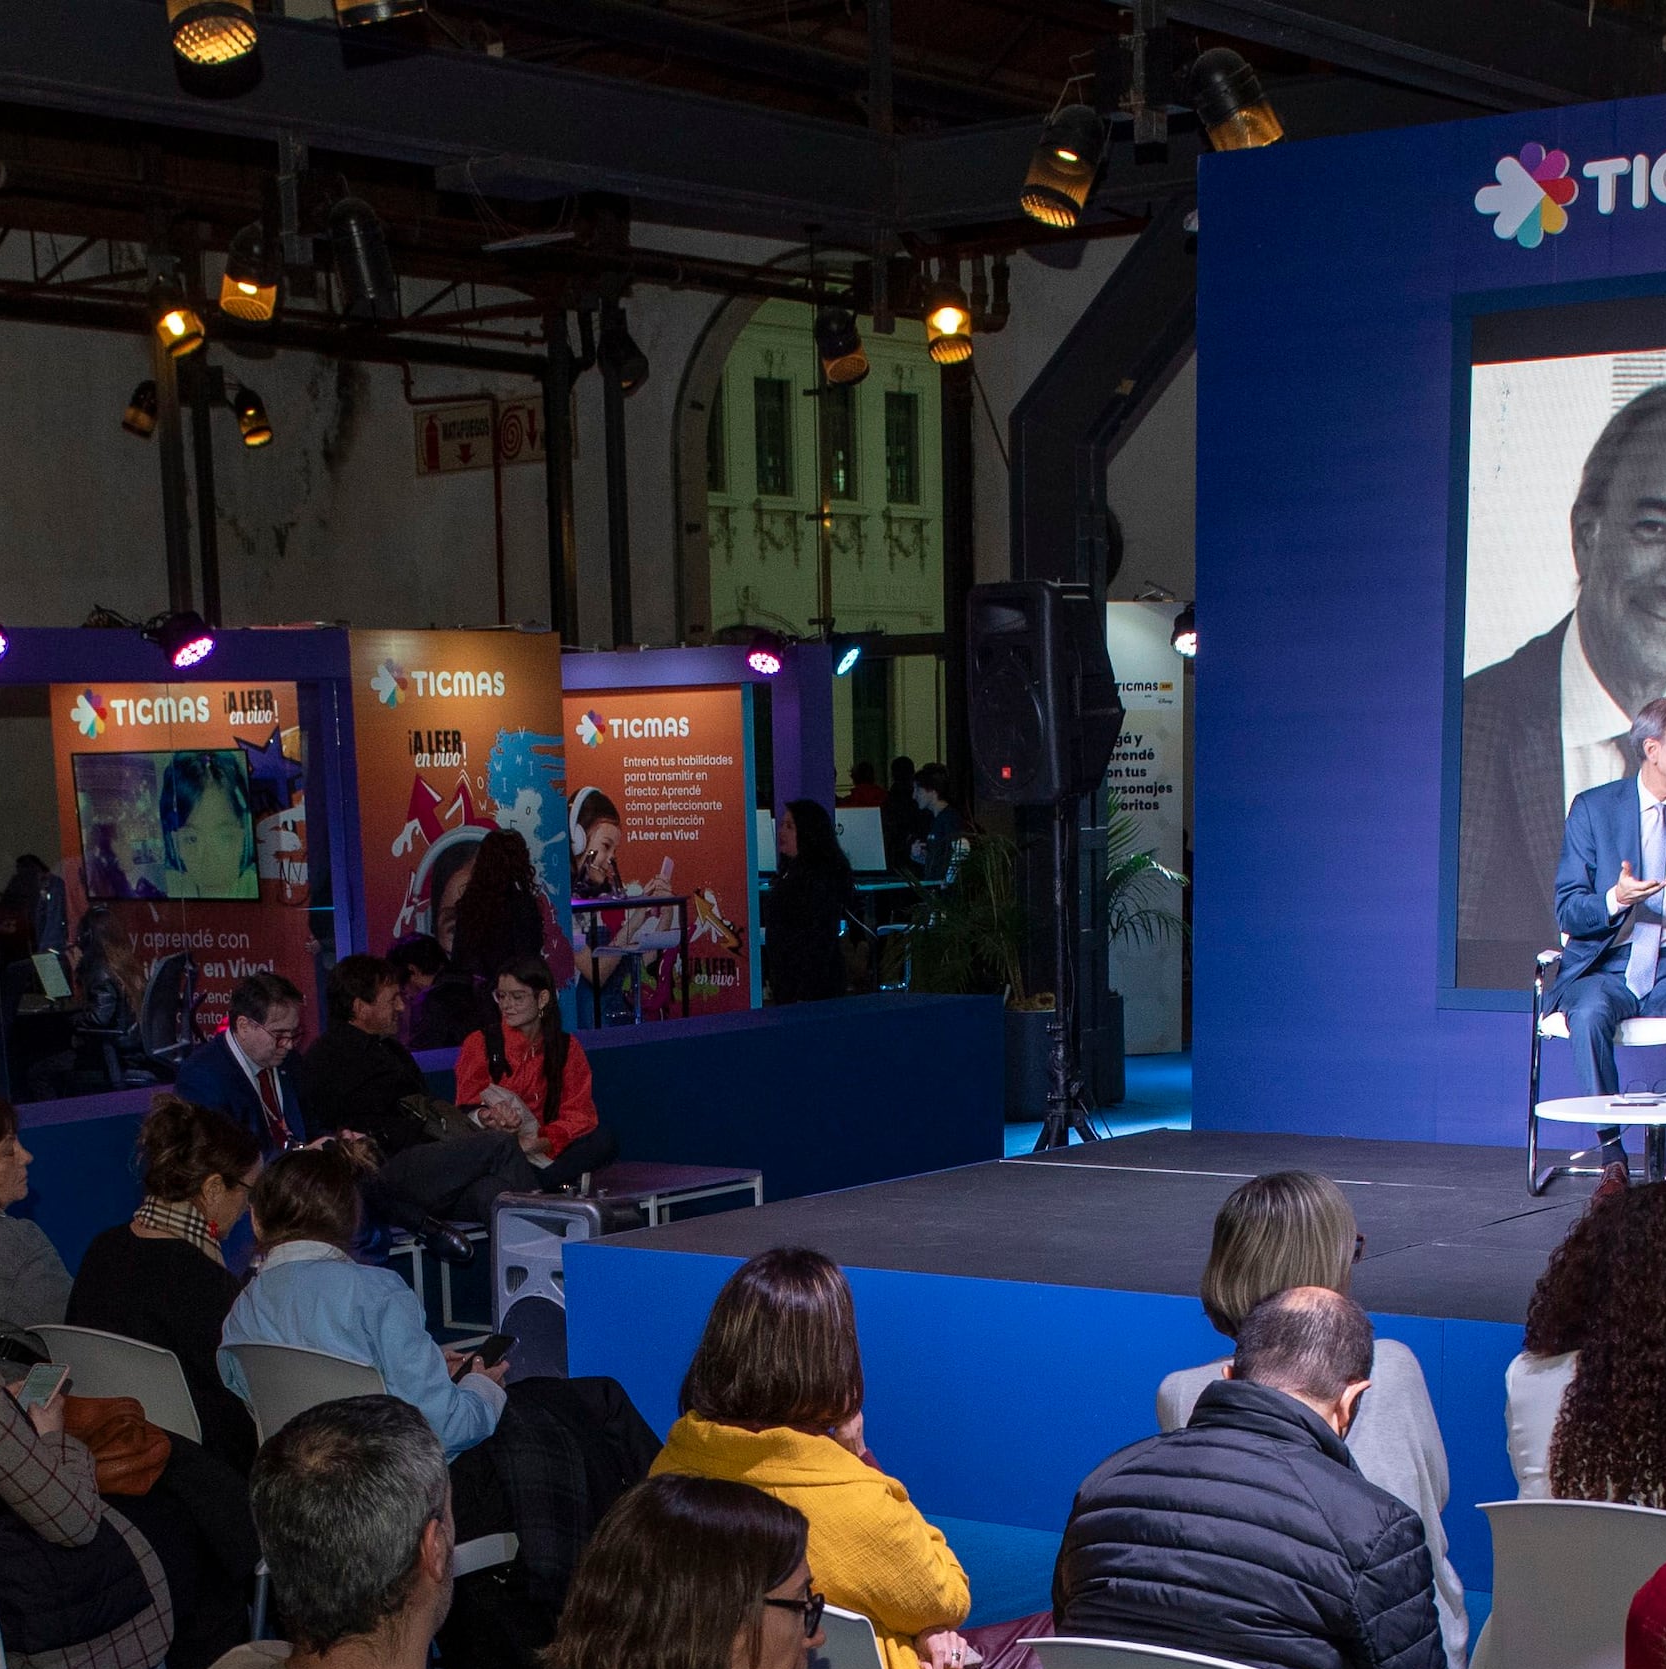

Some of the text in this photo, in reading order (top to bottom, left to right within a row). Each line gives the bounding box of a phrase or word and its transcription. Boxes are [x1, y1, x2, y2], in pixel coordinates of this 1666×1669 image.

[411, 671, 506, 697] TICMAS
[1117, 682, 1158, 692] TICMAS
[241, 689, 274, 711] LEER
[110, 696, 210, 726] TICMAS
[229, 708, 245, 726] en
[608, 716, 690, 739] TICMAS
[428, 730, 462, 755] LEER
[1134, 735, 1143, 748] y
[415, 751, 432, 768] en
[623, 755, 733, 768] Entrená tus habilidades
[624, 770, 708, 784] para transmitir en
[1107, 767, 1147, 778] on tus
[624, 785, 702, 798] directo: Aprendé
[625, 801, 723, 813] cómo perfeccionarte
[626, 815, 705, 828] con la aplicación
[639, 830, 659, 841] Leer
[660, 831, 672, 841] en
[673, 830, 699, 841] Vivo!
[129, 929, 250, 955] y aprendé con
[203, 962, 226, 978] en
